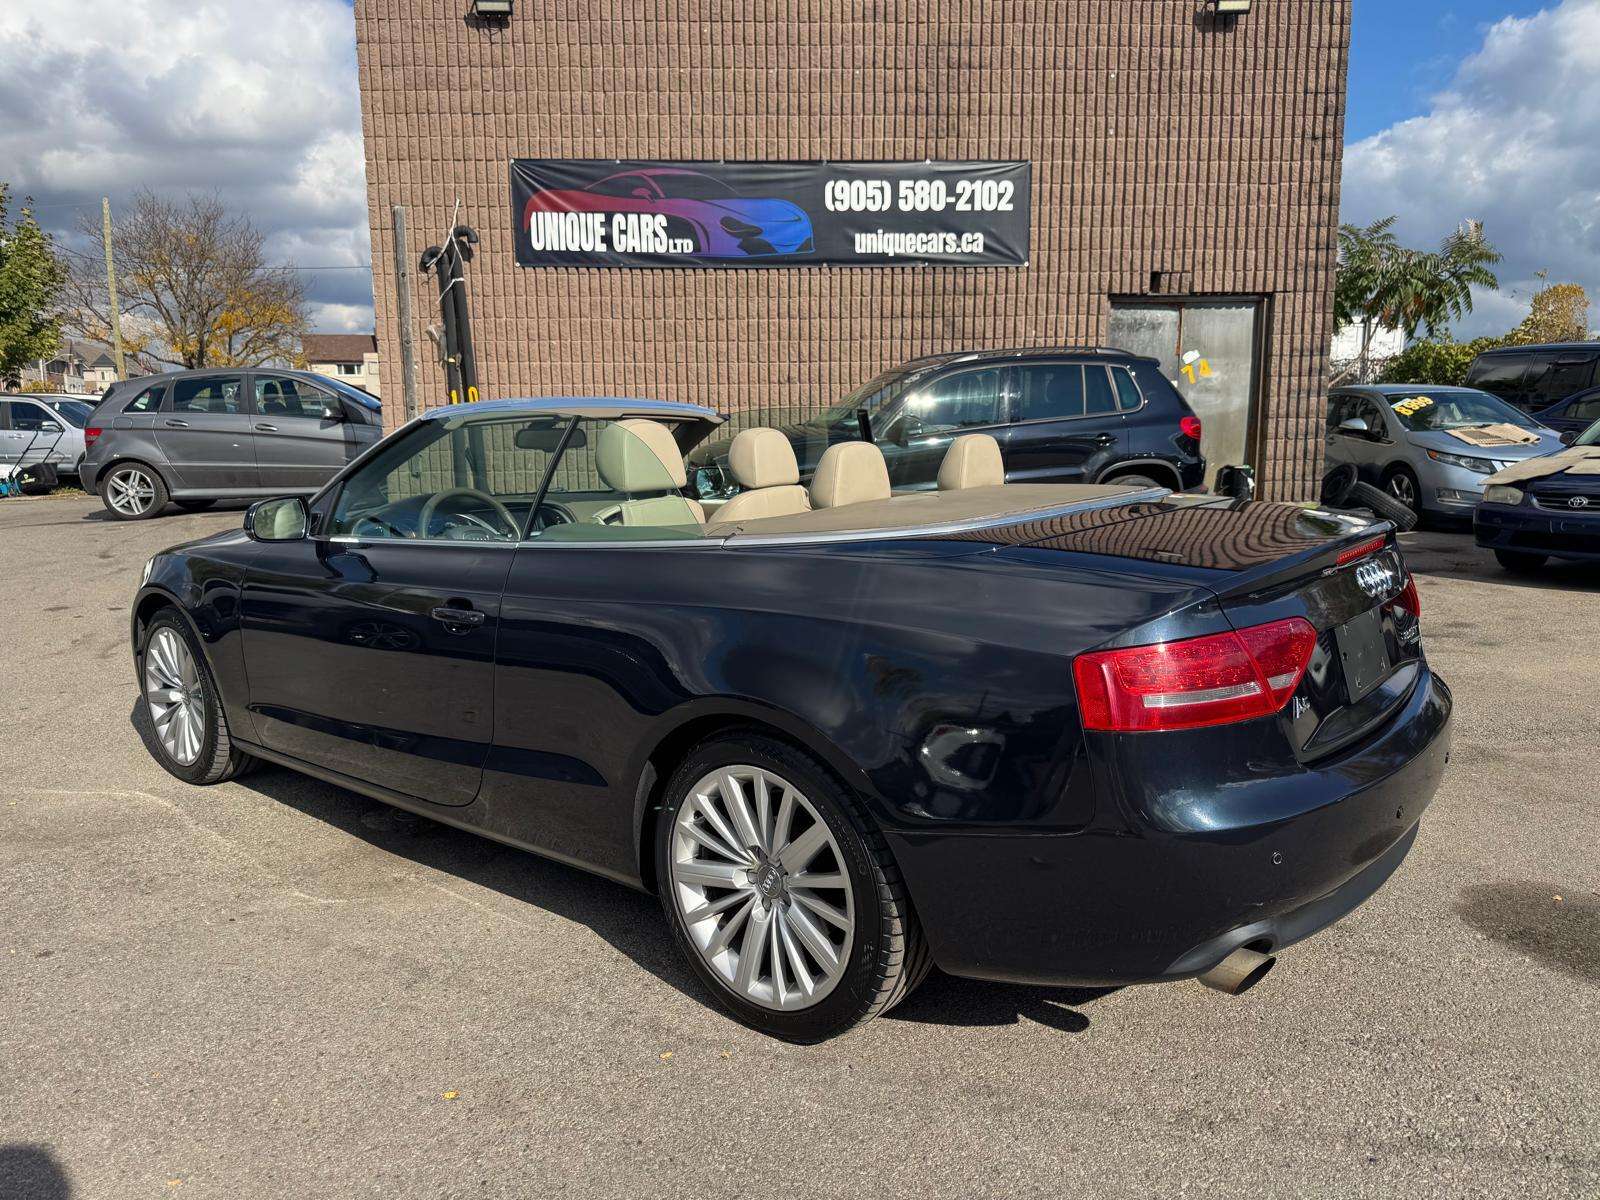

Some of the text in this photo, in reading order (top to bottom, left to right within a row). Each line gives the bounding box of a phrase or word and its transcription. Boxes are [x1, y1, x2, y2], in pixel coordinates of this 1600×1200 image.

[824, 179, 1015, 212] (905) 580-2102
[530, 211, 694, 253] UNIQUE CARS LTD
[854, 229, 984, 256] uniquecars.ca
